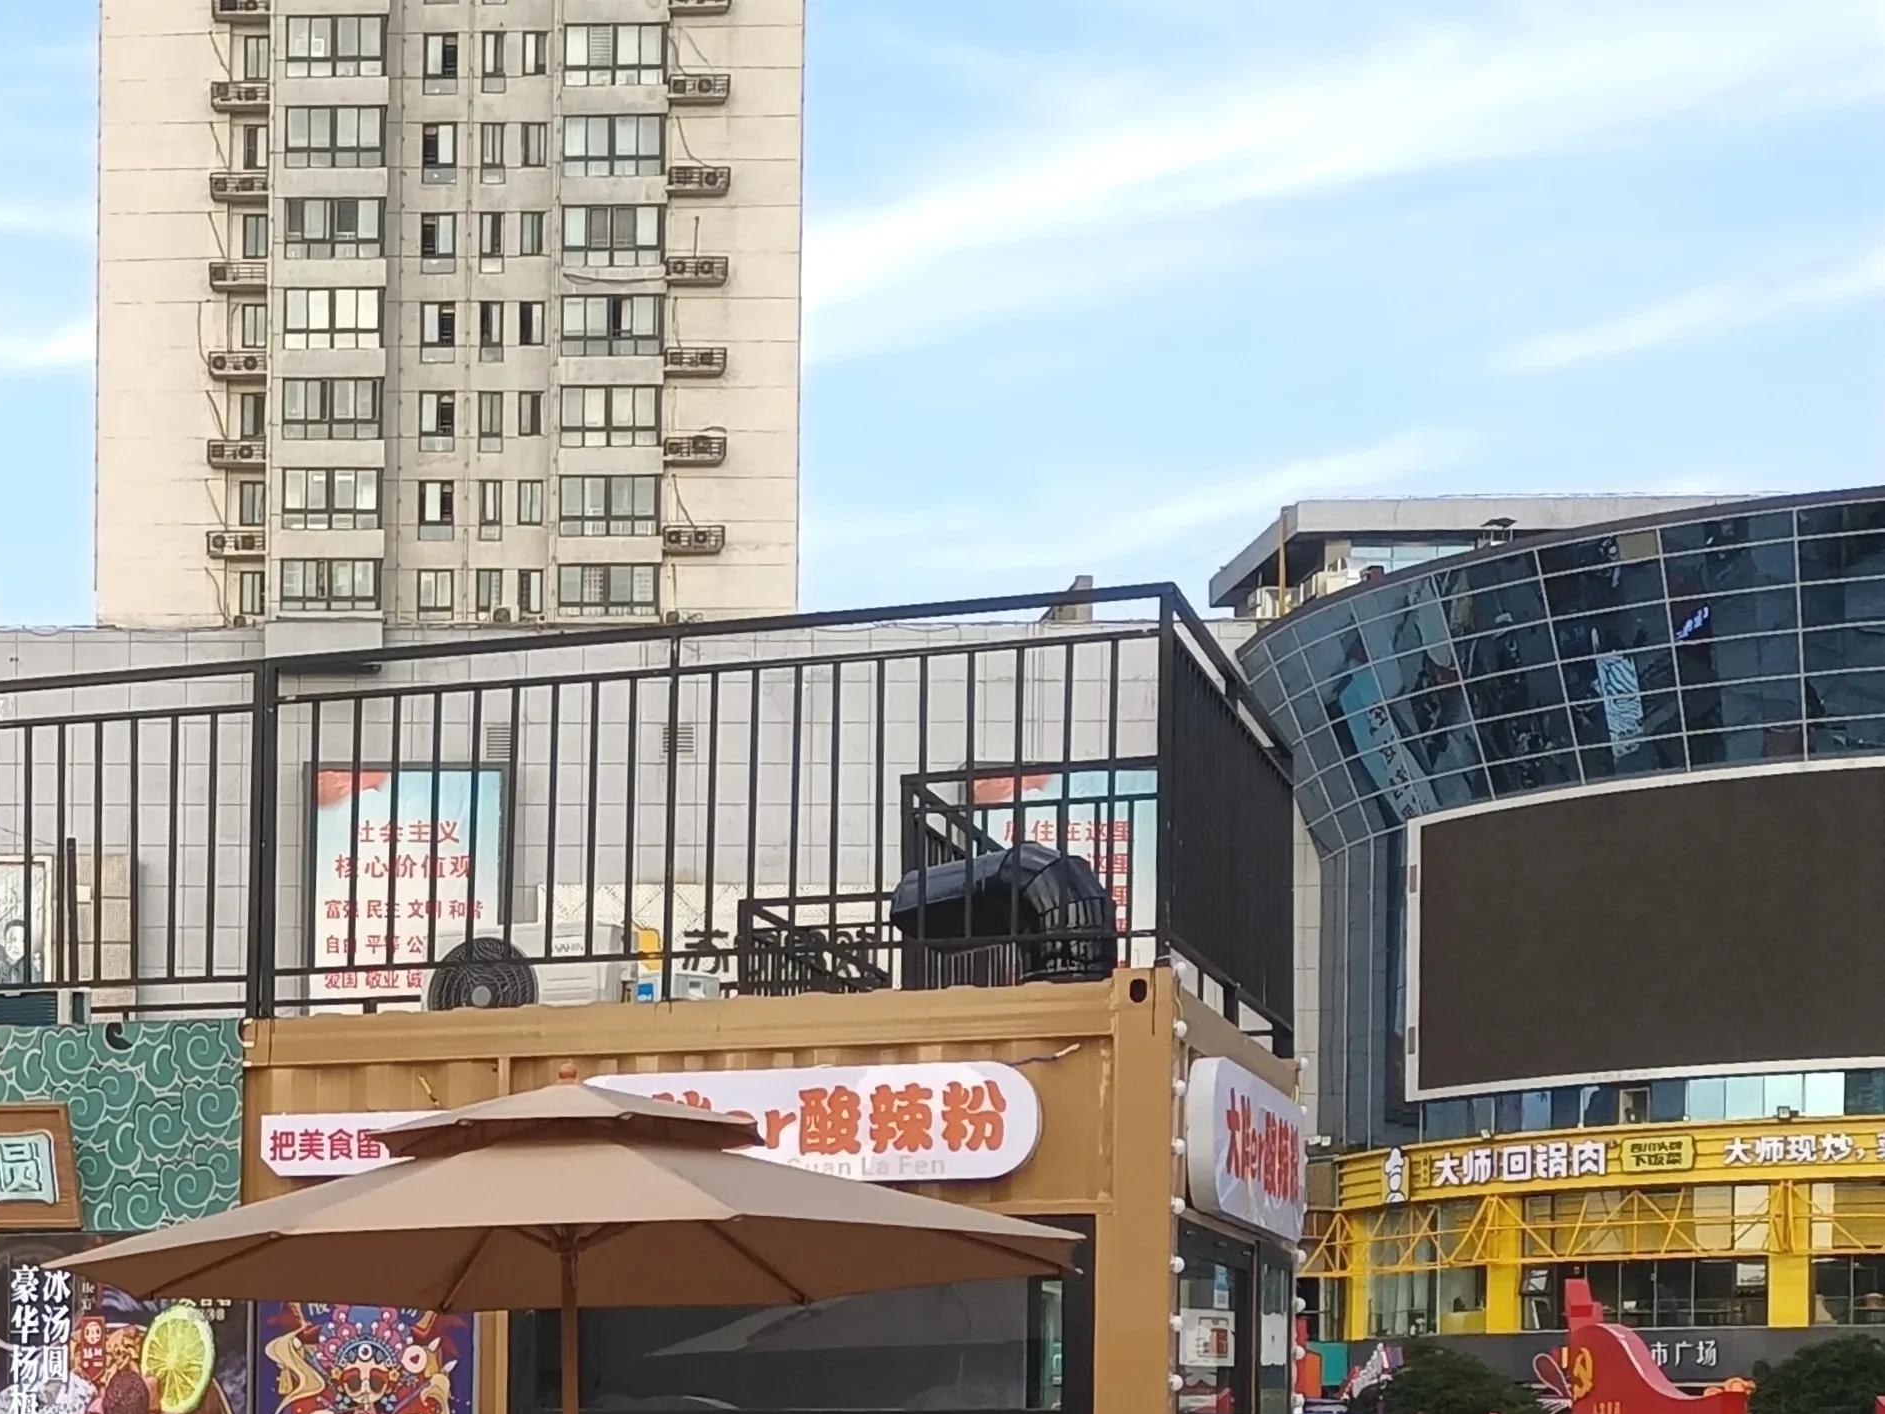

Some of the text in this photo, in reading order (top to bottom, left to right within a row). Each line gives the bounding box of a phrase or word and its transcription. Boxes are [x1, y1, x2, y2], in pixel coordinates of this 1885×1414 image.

[357, 820, 461, 844] 社会主义
[334, 854, 471, 879] 核心价值观
[652, 1080, 1007, 1155] r酸辣粉
[1723, 1132, 1885, 1166] 大师现炒，
[42, 1270, 72, 1384] 冰汤圆
